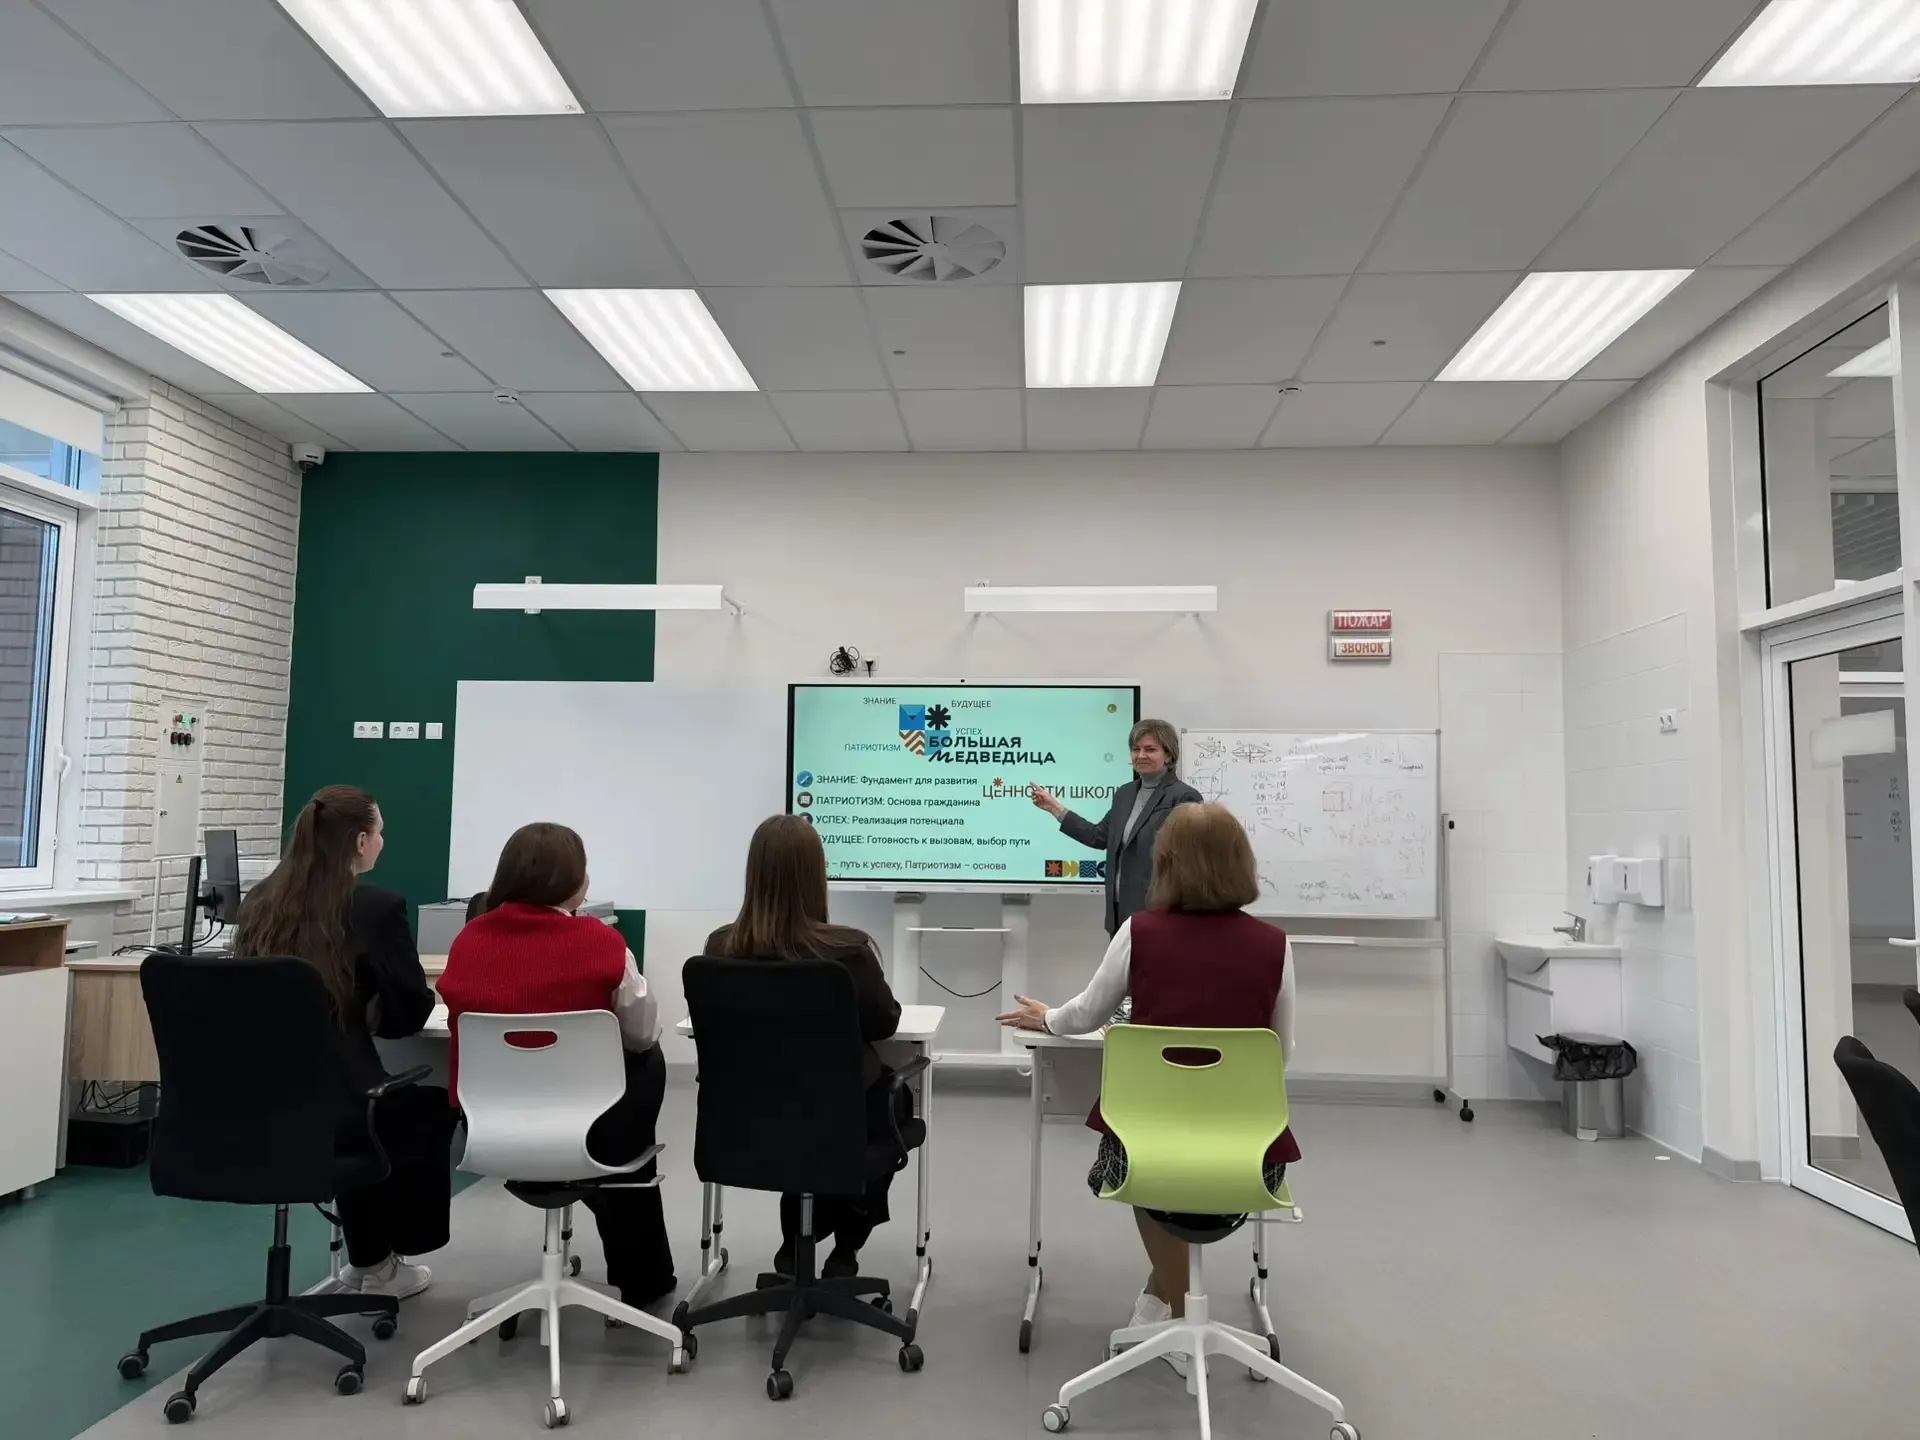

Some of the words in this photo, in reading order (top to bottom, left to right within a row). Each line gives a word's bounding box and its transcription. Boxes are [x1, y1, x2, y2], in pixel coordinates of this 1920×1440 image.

[1338, 614, 1388, 628] ПОЖАР
[1341, 642, 1384, 654] ЗВОНОК
[862, 697, 897, 705] ЗНАНИЕ
[951, 700, 992, 709] БУДУЩЕЕ
[955, 728, 983, 736] УСПЕХ
[844, 743, 901, 752] ПАТРИОТИЗМ
[929, 736, 1022, 748] БОЛЬШАЯ
[928, 750, 1057, 765] МЕДВЕДИЦА
[816, 775, 859, 785] ЗНАНИЕ:
[860, 775, 913, 786] Фундамент
[915, 776, 933, 786] для
[934, 777, 978, 787] развития
[982, 784, 1065, 800] ЦЕННОТИ
[1070, 785, 1119, 799] ШКОЛ
[816, 796, 886, 806] ПАТРИОТИЗМ:
[887, 797, 922, 807] Основа
[924, 799, 981, 808] гражданина
[815, 815, 851, 825] УСПЕХ:
[852, 816, 908, 826] Реализация
[909, 817, 965, 827] потенциала
[819, 834, 865, 845] УДУЩЕЕ:
[867, 835, 920, 845] Готовность
[929, 838, 975, 847] вызовам,
[976, 837, 1007, 847] выбор
[1009, 839, 1031, 848] пути
[840, 861, 861, 870] путь
[862, 861, 869, 869] к
[870, 862, 903, 871] успеху,
[904, 860, 962, 871] Патриотизм
[972, 862, 1007, 871] основа
